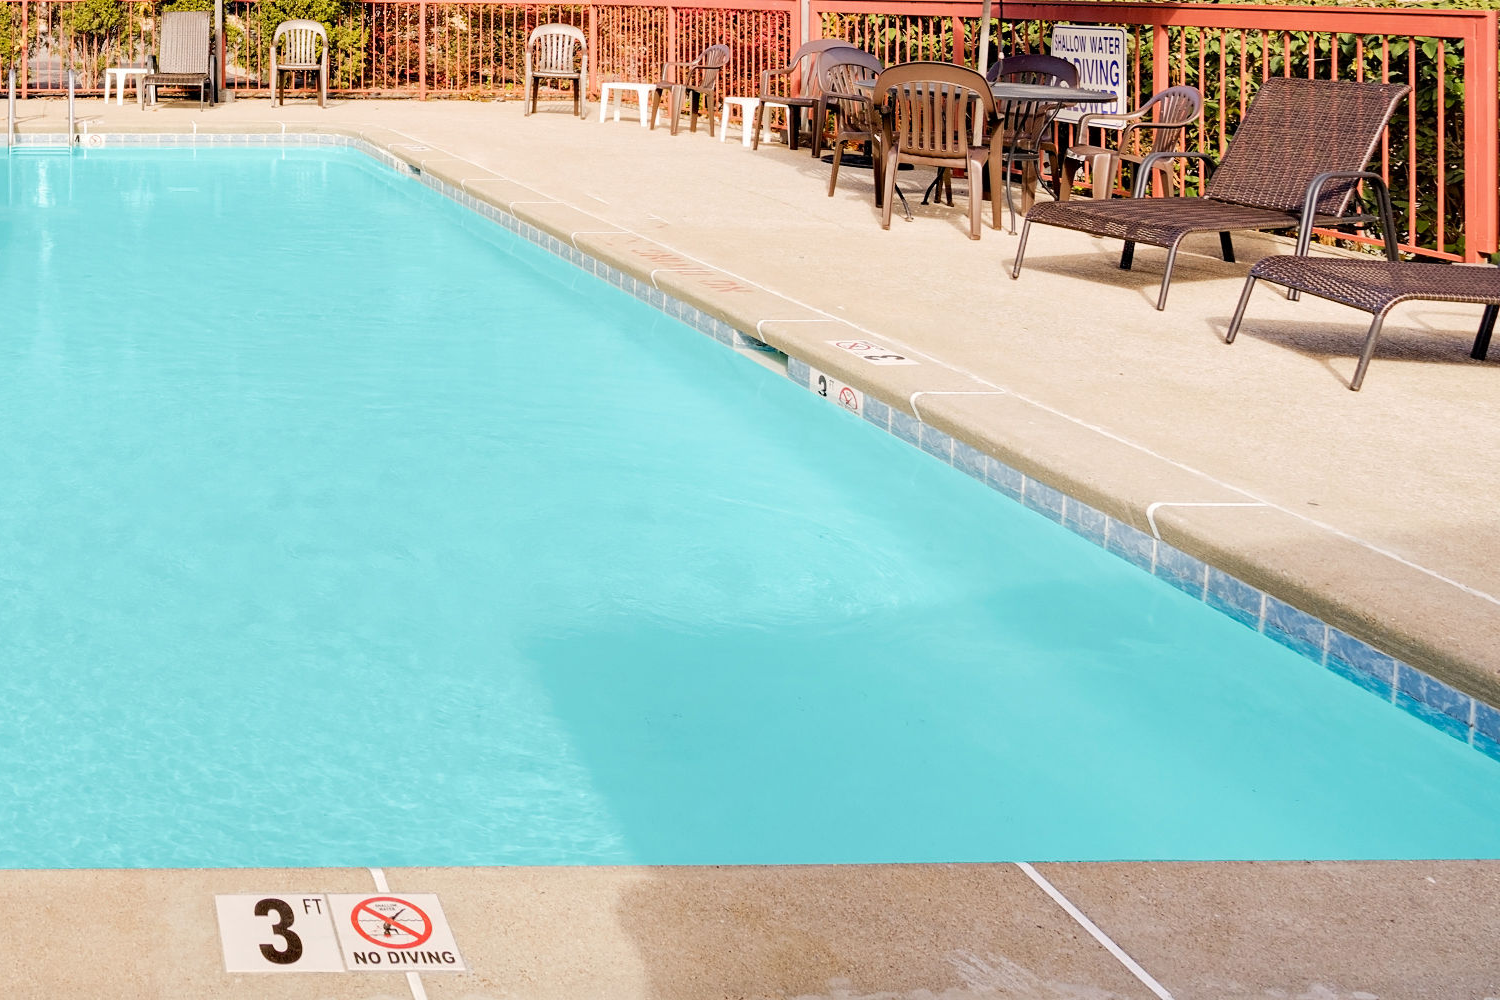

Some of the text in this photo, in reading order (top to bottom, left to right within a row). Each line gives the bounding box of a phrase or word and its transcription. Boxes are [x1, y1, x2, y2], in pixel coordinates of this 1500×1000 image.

[1054, 34, 1120, 55] SHALLOW WATER
[1074, 57, 1120, 87] DIVING
[253, 897, 322, 965] 3 FT
[352, 951, 456, 965] NO DIVING
